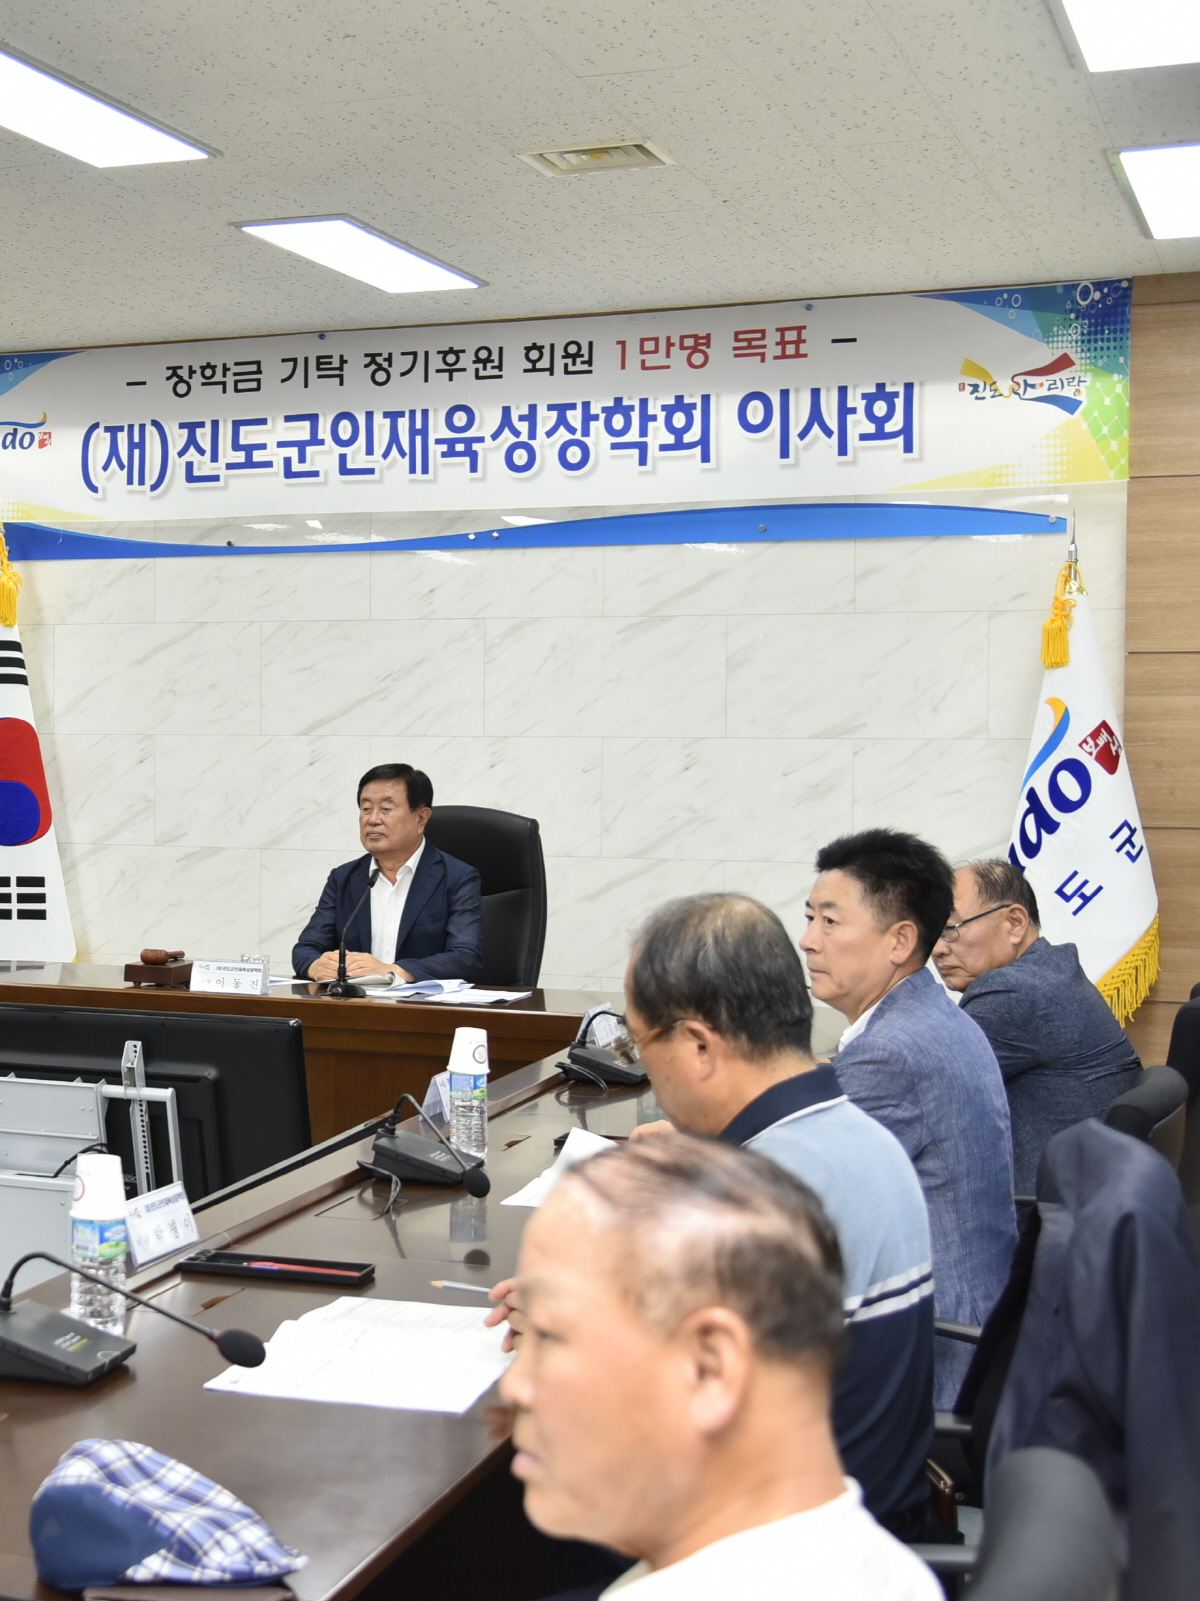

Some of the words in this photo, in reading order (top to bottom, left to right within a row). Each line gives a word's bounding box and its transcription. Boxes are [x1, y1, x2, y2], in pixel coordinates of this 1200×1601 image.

[165, 359, 263, 399] 장학금
[280, 353, 348, 389] 기탁
[363, 345, 504, 387] 정기후원
[522, 339, 595, 377] 회원
[615, 331, 712, 371] 1만명
[731, 325, 810, 364] 목표
[81, 393, 713, 494] (재)진도군인재육성장학회
[736, 381, 915, 459] 이사회
